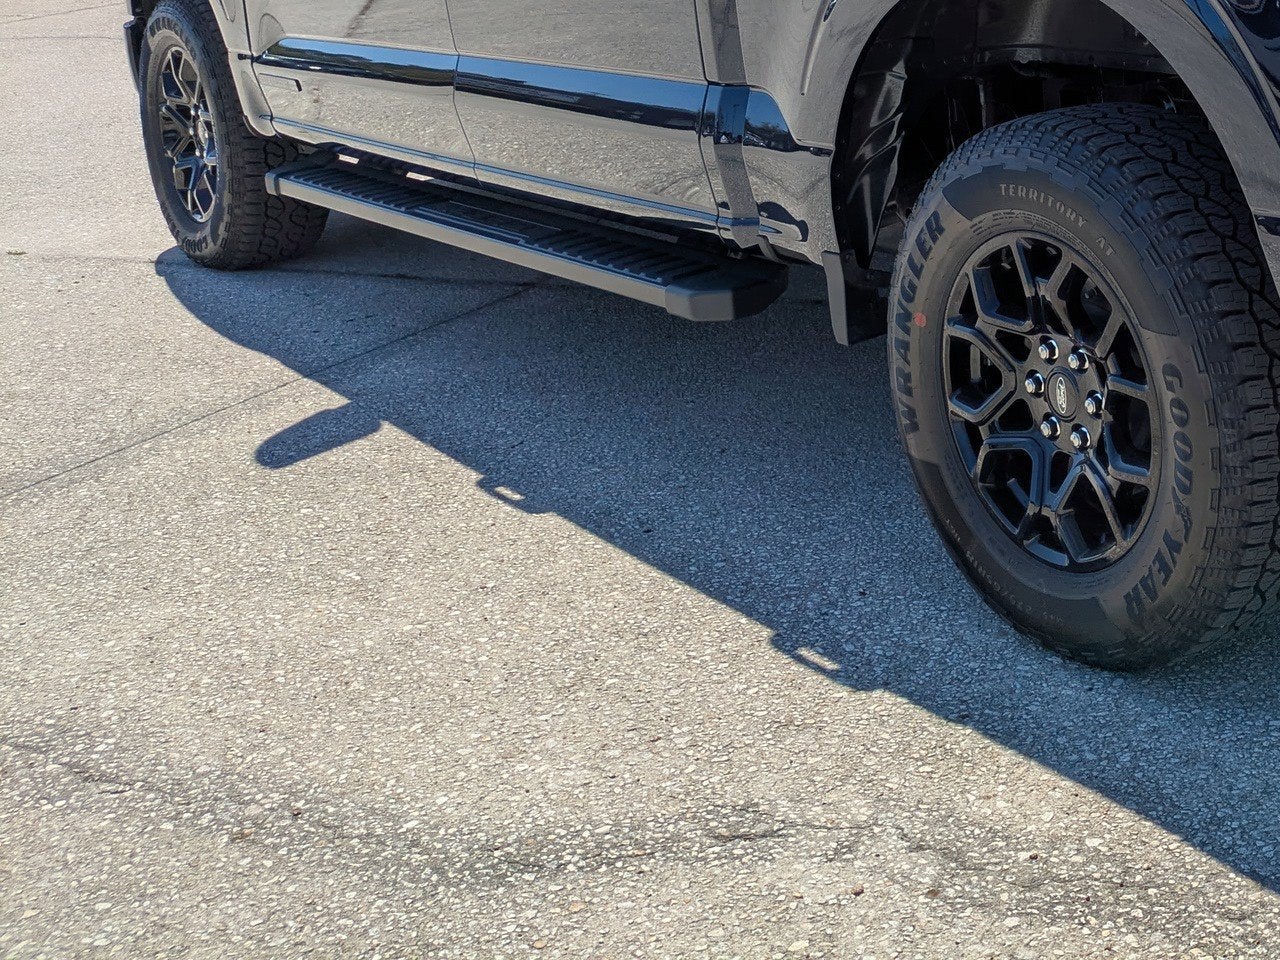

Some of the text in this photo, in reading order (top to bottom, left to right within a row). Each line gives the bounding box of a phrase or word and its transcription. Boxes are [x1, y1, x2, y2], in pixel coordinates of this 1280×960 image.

[894, 210, 946, 435] WRANGLER
[999, 183, 1117, 257] TERRITORY AT
[1122, 362, 1194, 620] GOODYEAR
